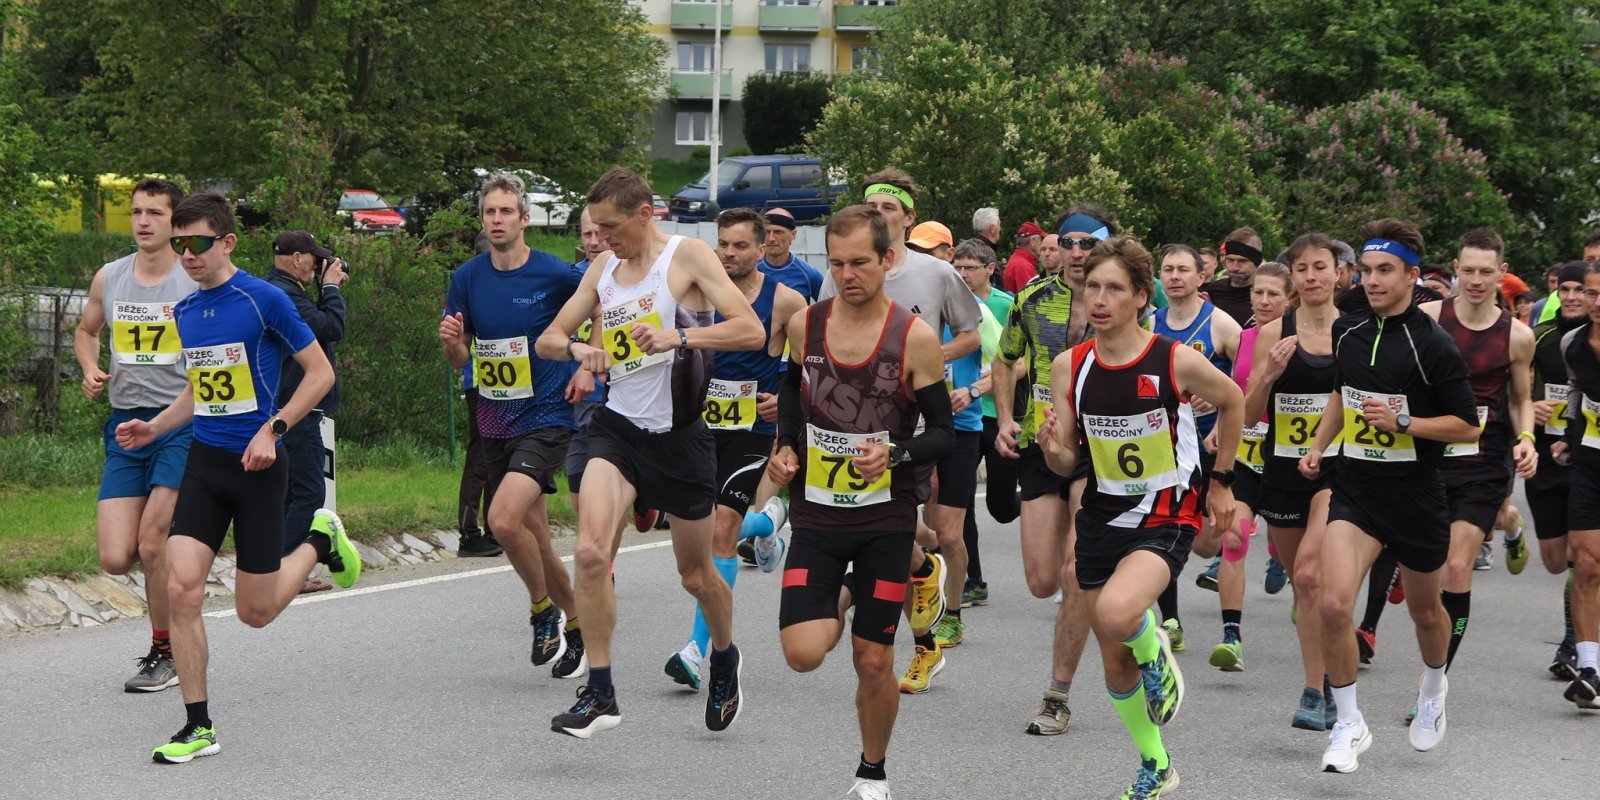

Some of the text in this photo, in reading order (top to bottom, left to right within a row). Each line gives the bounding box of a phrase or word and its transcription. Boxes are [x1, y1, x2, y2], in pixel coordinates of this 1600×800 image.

[118, 304, 148, 314] BĚŽEC
[117, 314, 159, 322] VYSOČINY
[128, 325, 166, 351] 17
[612, 329, 631, 361] 3
[480, 360, 517, 387] 30
[199, 370, 235, 402] 53
[1280, 396, 1314, 405] BĚŽEC
[1280, 405, 1326, 413] VYSOČINY
[705, 400, 742, 425] 84
[1089, 416, 1129, 427] BĚŽEC
[813, 430, 849, 445] BĚŽEC
[1090, 428, 1144, 438] VYSOČINY
[814, 438, 862, 455] VYSOČINY
[1117, 443, 1145, 479] 6
[821, 455, 870, 491] 79
